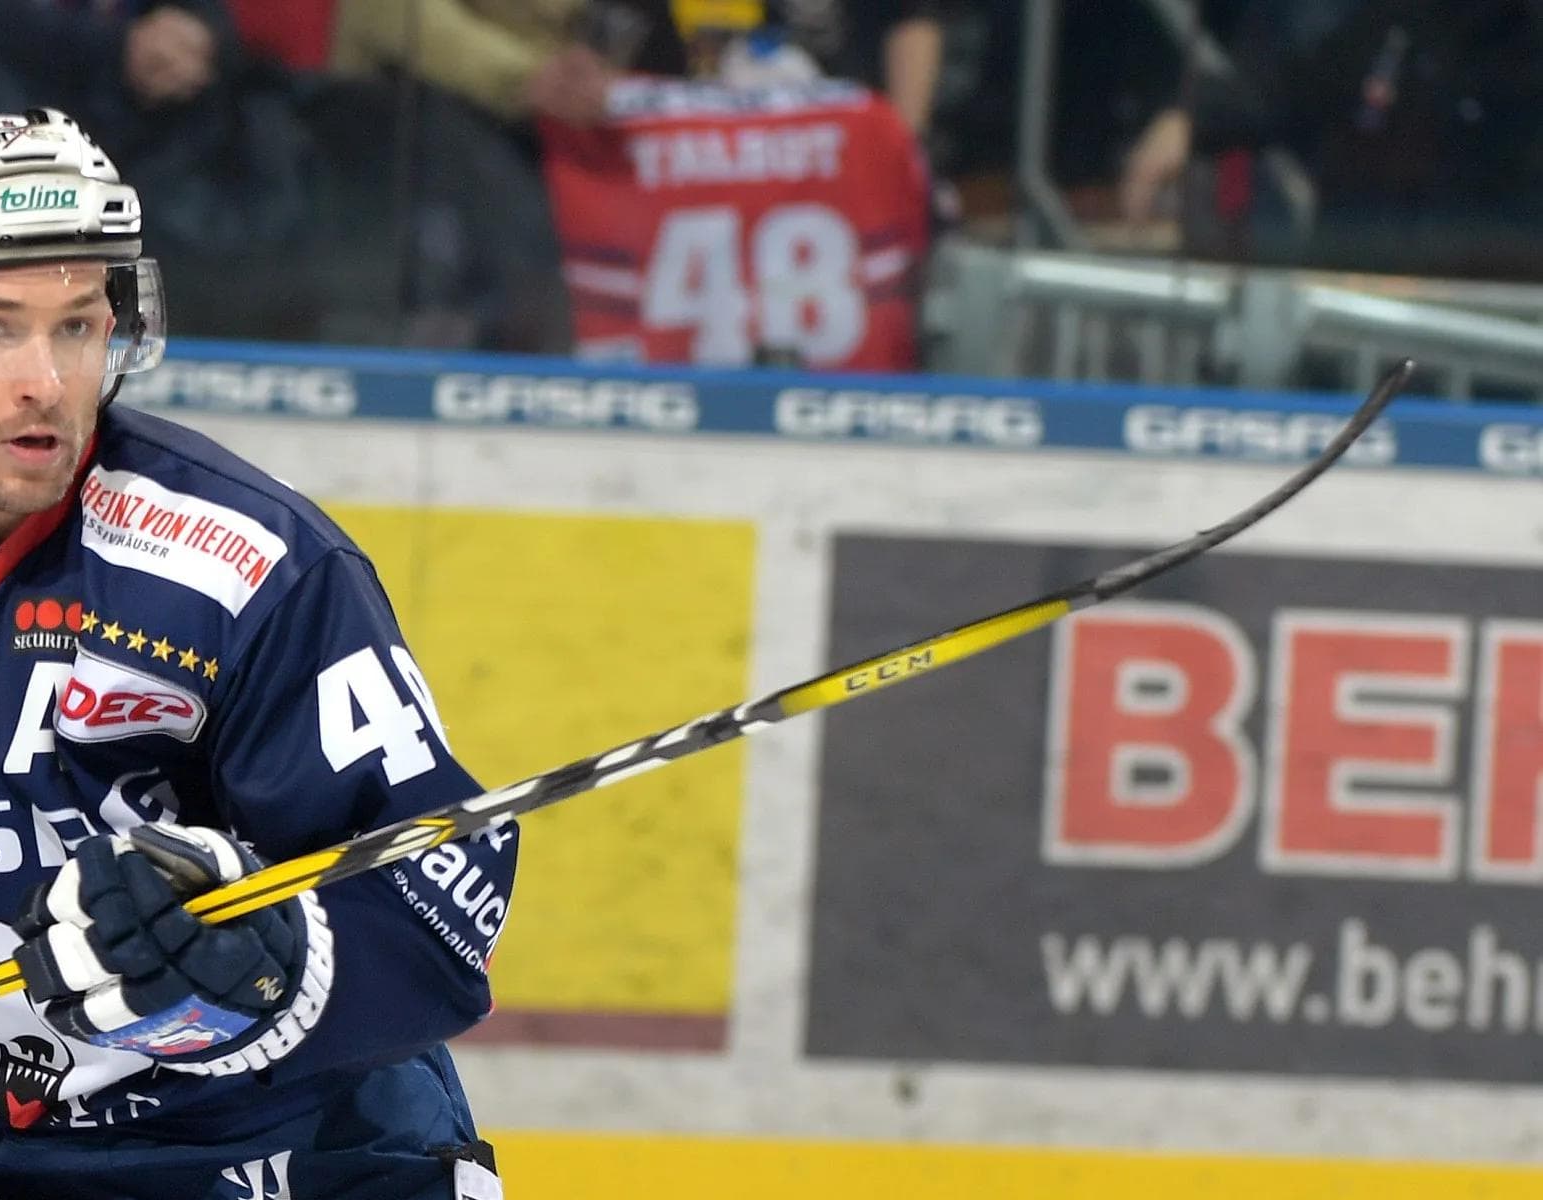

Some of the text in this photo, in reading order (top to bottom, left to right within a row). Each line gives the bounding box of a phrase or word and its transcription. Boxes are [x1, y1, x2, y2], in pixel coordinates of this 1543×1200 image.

[642, 204, 868, 370] 48
[433, 372, 699, 431] GASAG
[774, 388, 1043, 447] GASAG
[1123, 405, 1398, 466] GASAG
[82, 475, 273, 589] HEINZ VON HEIDEN
[13, 631, 80, 651] SECURITA
[844, 648, 935, 694] CCM
